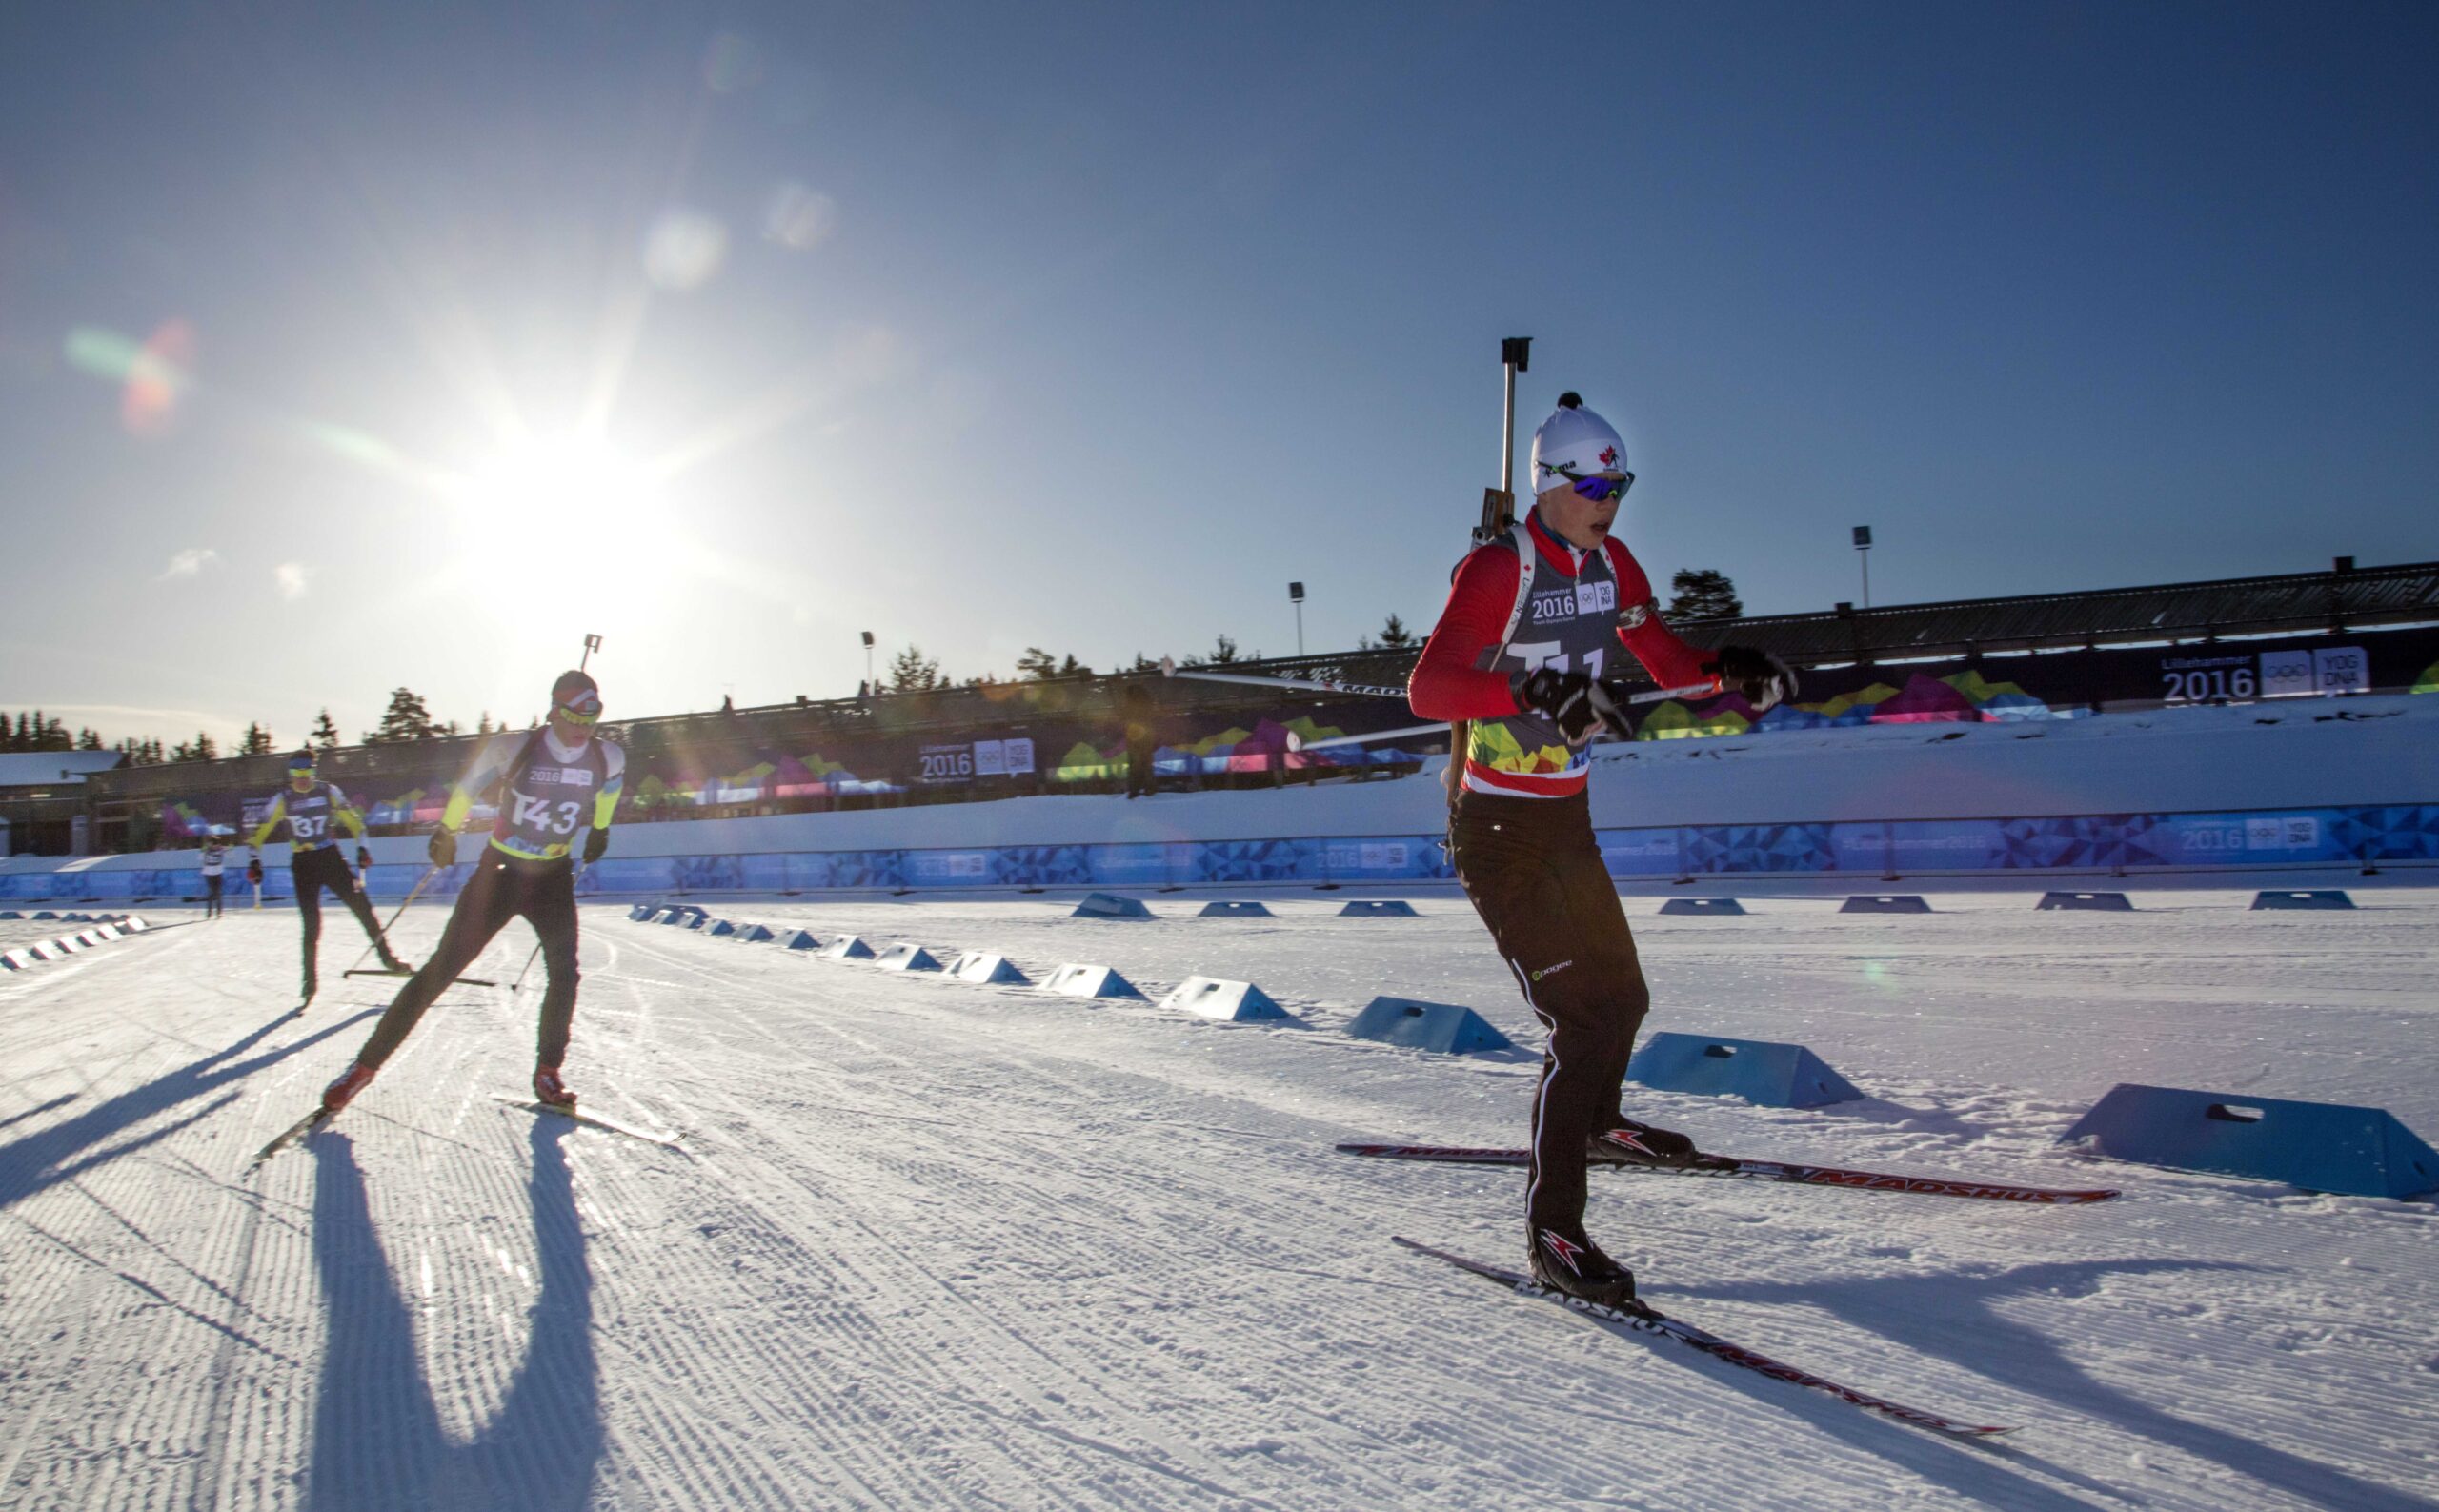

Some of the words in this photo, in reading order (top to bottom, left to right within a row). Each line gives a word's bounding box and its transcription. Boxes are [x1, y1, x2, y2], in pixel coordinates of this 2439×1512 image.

[1532, 595, 1575, 620] 2016
[2162, 655, 2252, 670] Lillehammer
[2163, 668, 2255, 701] 2016
[530, 770, 560, 782] 2016
[920, 753, 972, 776] 2016
[511, 787, 581, 835] T43
[2182, 829, 2243, 850] 2016
[1809, 1170, 2058, 1202] MADSHUS
